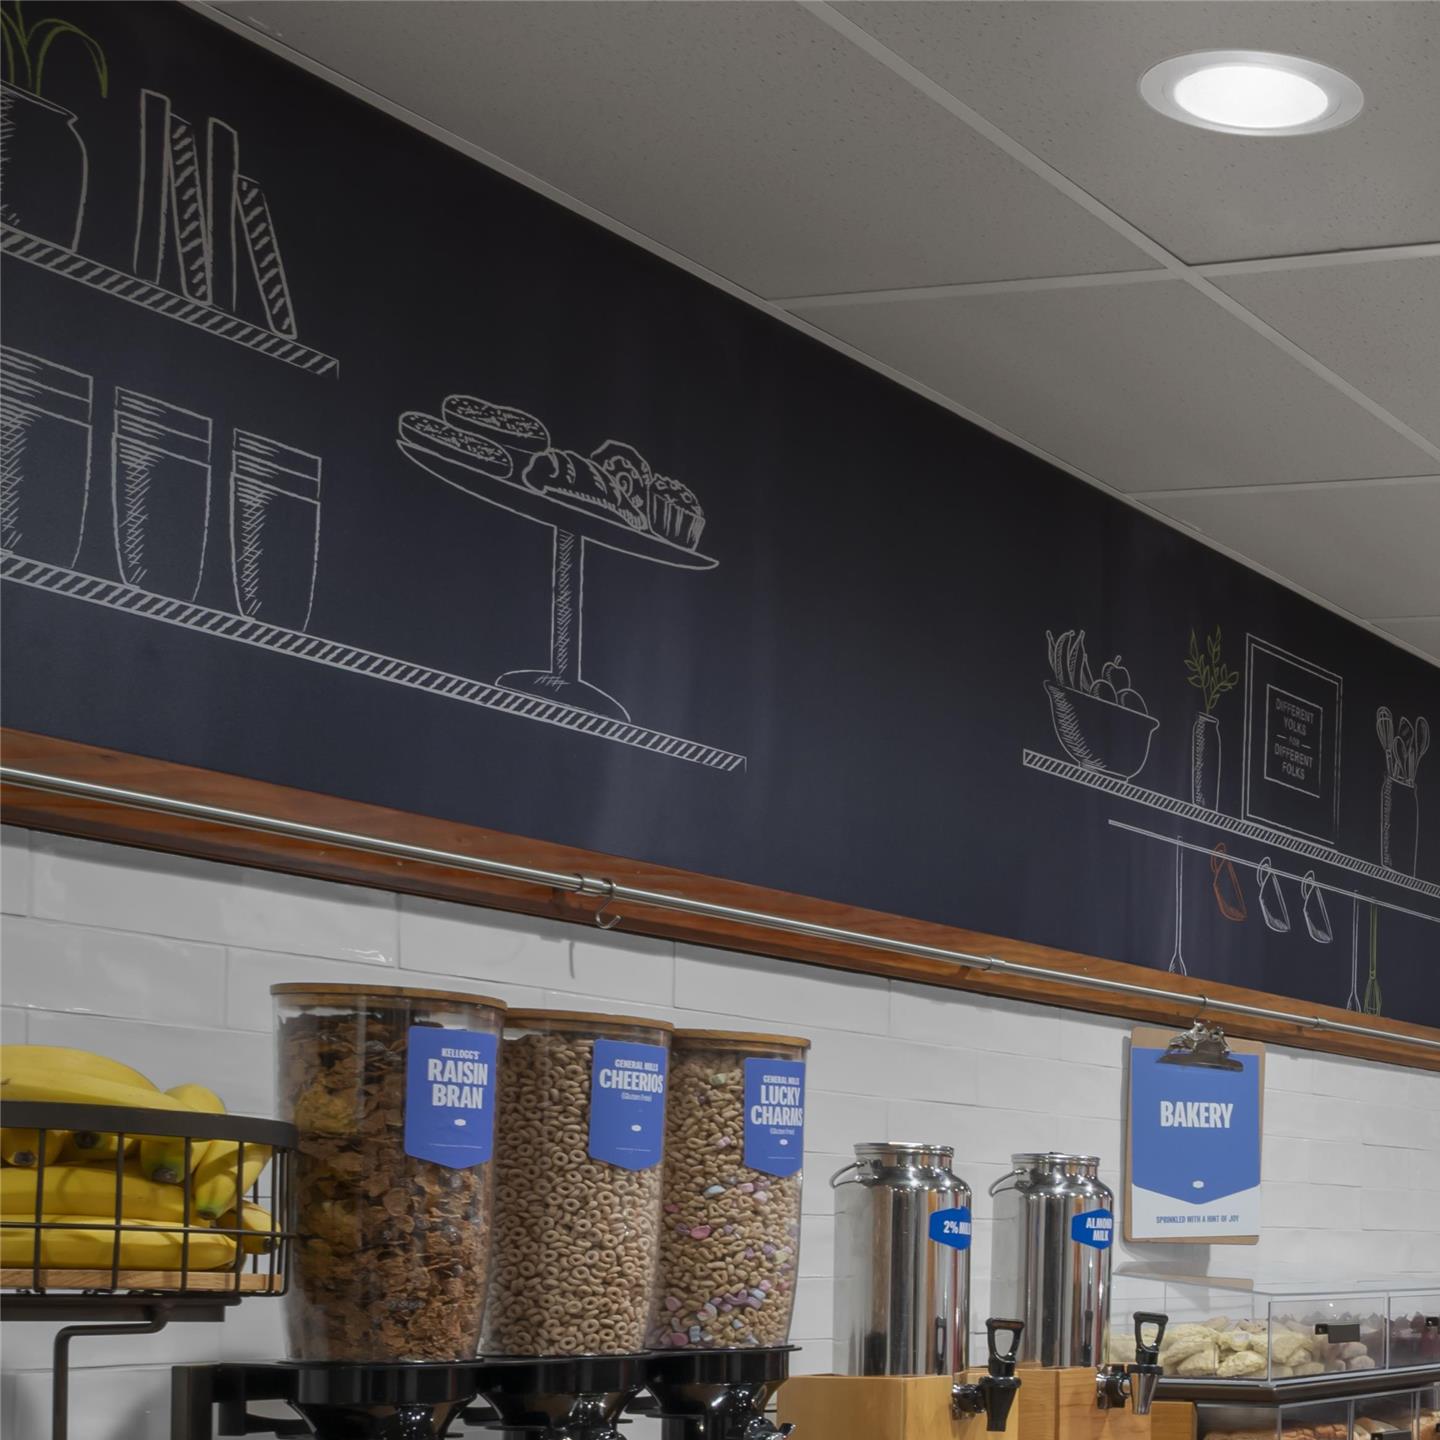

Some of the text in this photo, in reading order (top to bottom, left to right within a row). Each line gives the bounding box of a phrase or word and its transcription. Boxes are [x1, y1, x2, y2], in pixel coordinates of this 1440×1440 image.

[1275, 698, 1314, 725] DIFFERENT
[1283, 717, 1307, 737] YOLKS
[1274, 743, 1313, 769] DIFFERENT
[1281, 761, 1305, 780] FOLKS
[441, 1048, 481, 1060] KELLOGG'S
[428, 1059, 488, 1085] RAISIN
[615, 1059, 643, 1070] GENERAL
[599, 1068, 664, 1094] CHEERIOS
[763, 1075, 786, 1085] GENERAL
[432, 1084, 483, 1109] BRAN
[761, 1085, 801, 1106] LUCKY
[751, 1105, 803, 1127] CHARMS
[1160, 1100, 1233, 1128] BAKERY
[943, 1220, 959, 1234] 2%
[1086, 1217, 1112, 1229] ALMOND
[1093, 1229, 1109, 1241] MILK
